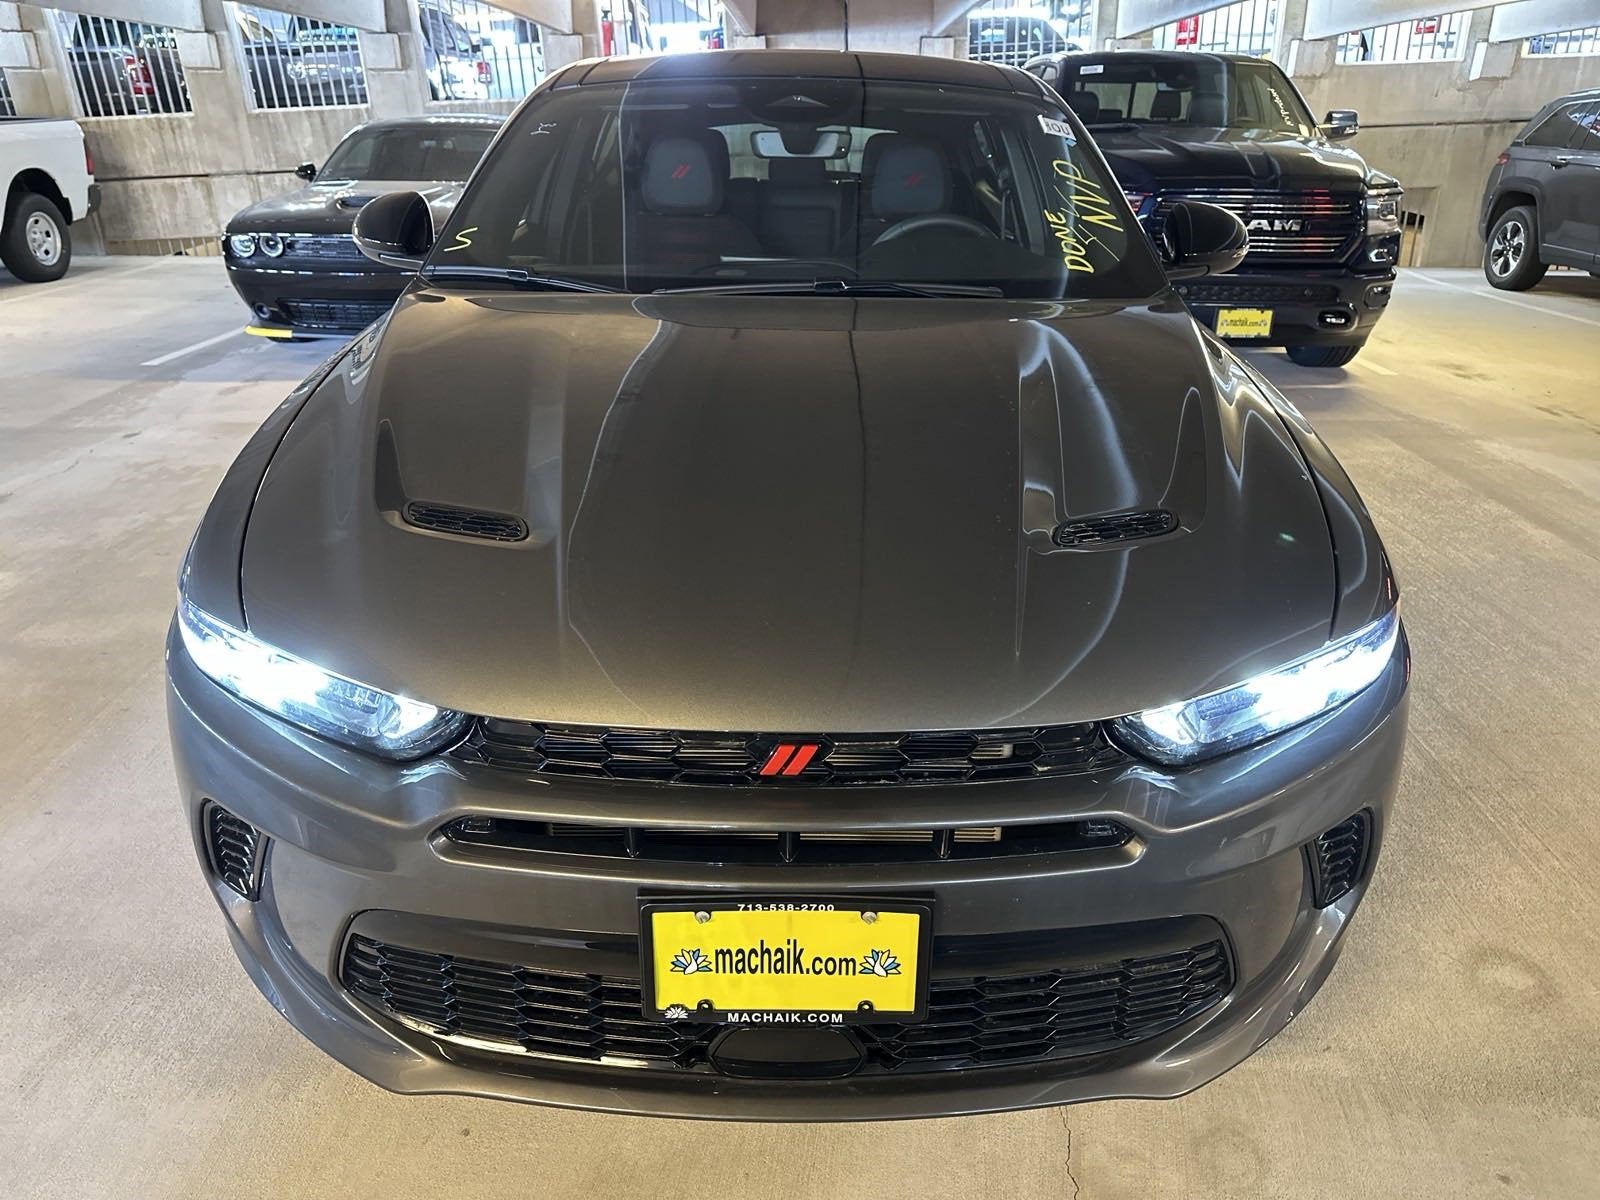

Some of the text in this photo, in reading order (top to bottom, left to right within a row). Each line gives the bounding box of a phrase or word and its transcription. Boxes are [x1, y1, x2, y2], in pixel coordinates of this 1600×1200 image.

[1246, 218, 1302, 232] AM
[443, 226, 479, 252] S
[1044, 209, 1095, 274] DONE
[737, 903, 835, 912] 713-538-2700
[714, 938, 857, 977] machaik.com
[727, 1012, 844, 1024] MACHAIK.COM
